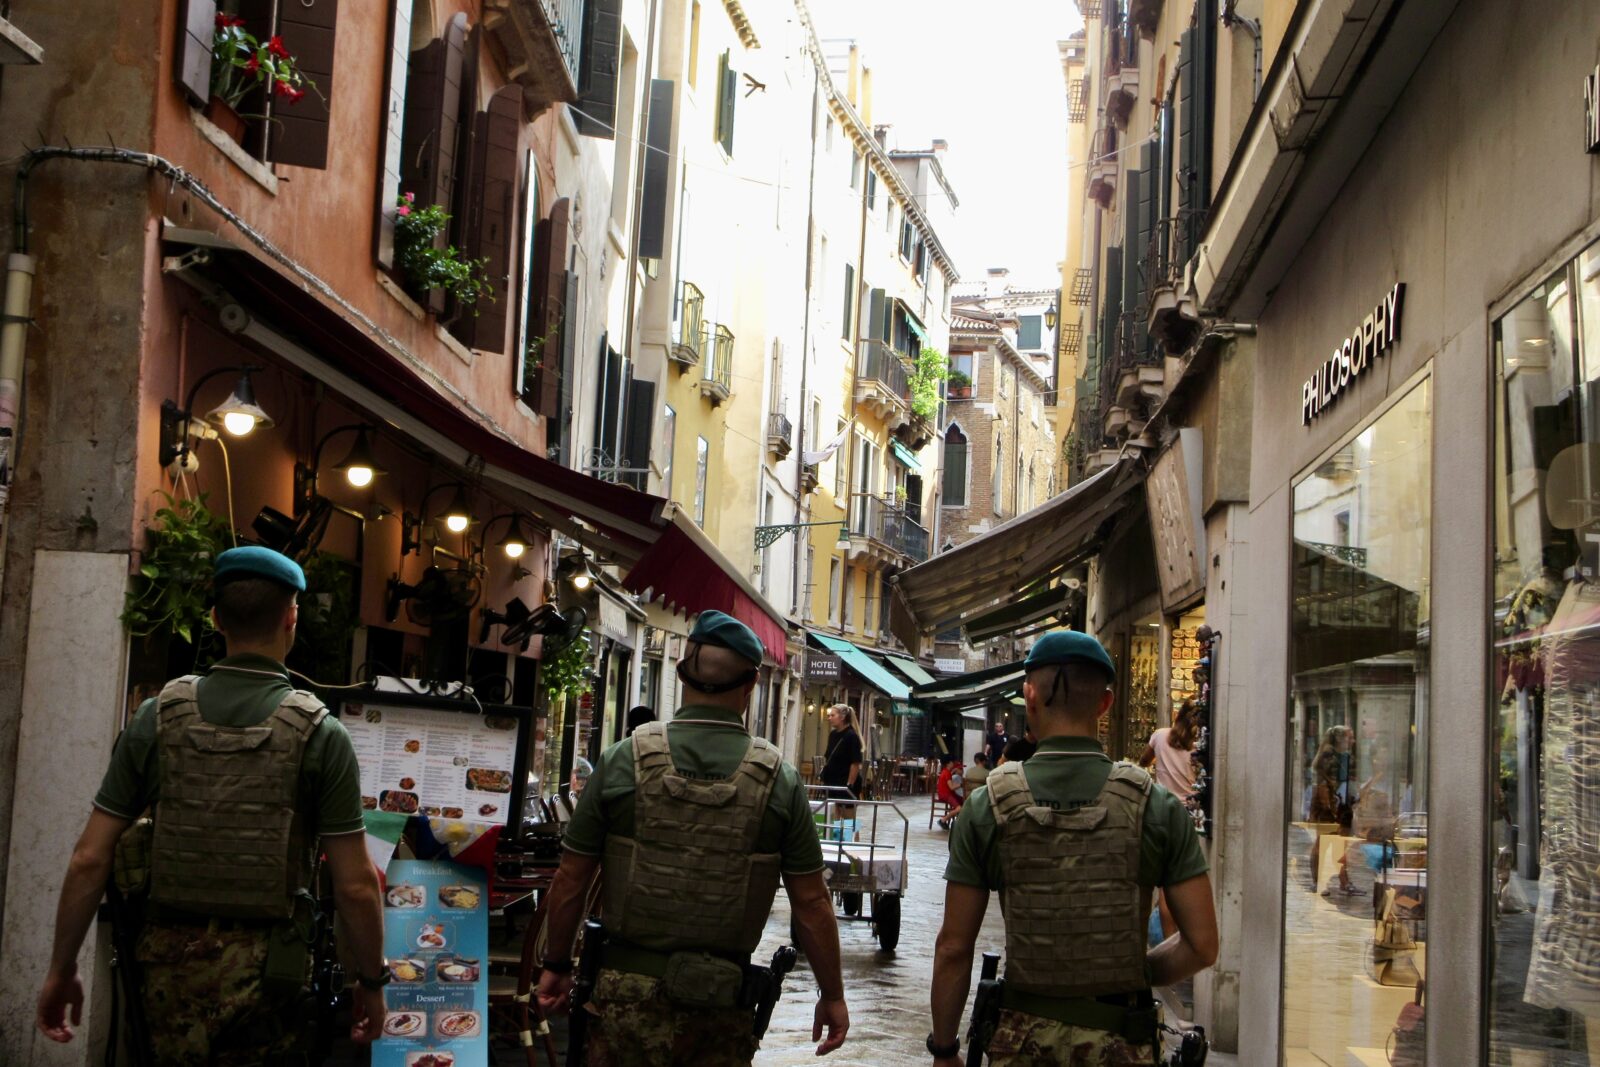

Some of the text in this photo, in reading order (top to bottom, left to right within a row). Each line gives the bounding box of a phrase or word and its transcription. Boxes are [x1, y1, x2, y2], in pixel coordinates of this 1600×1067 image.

[1302, 282, 1406, 426] PHILOSOPHY
[811, 661, 838, 669] HOTEL
[412, 866, 452, 876] Breakfast
[416, 994, 445, 1002] Dessert
